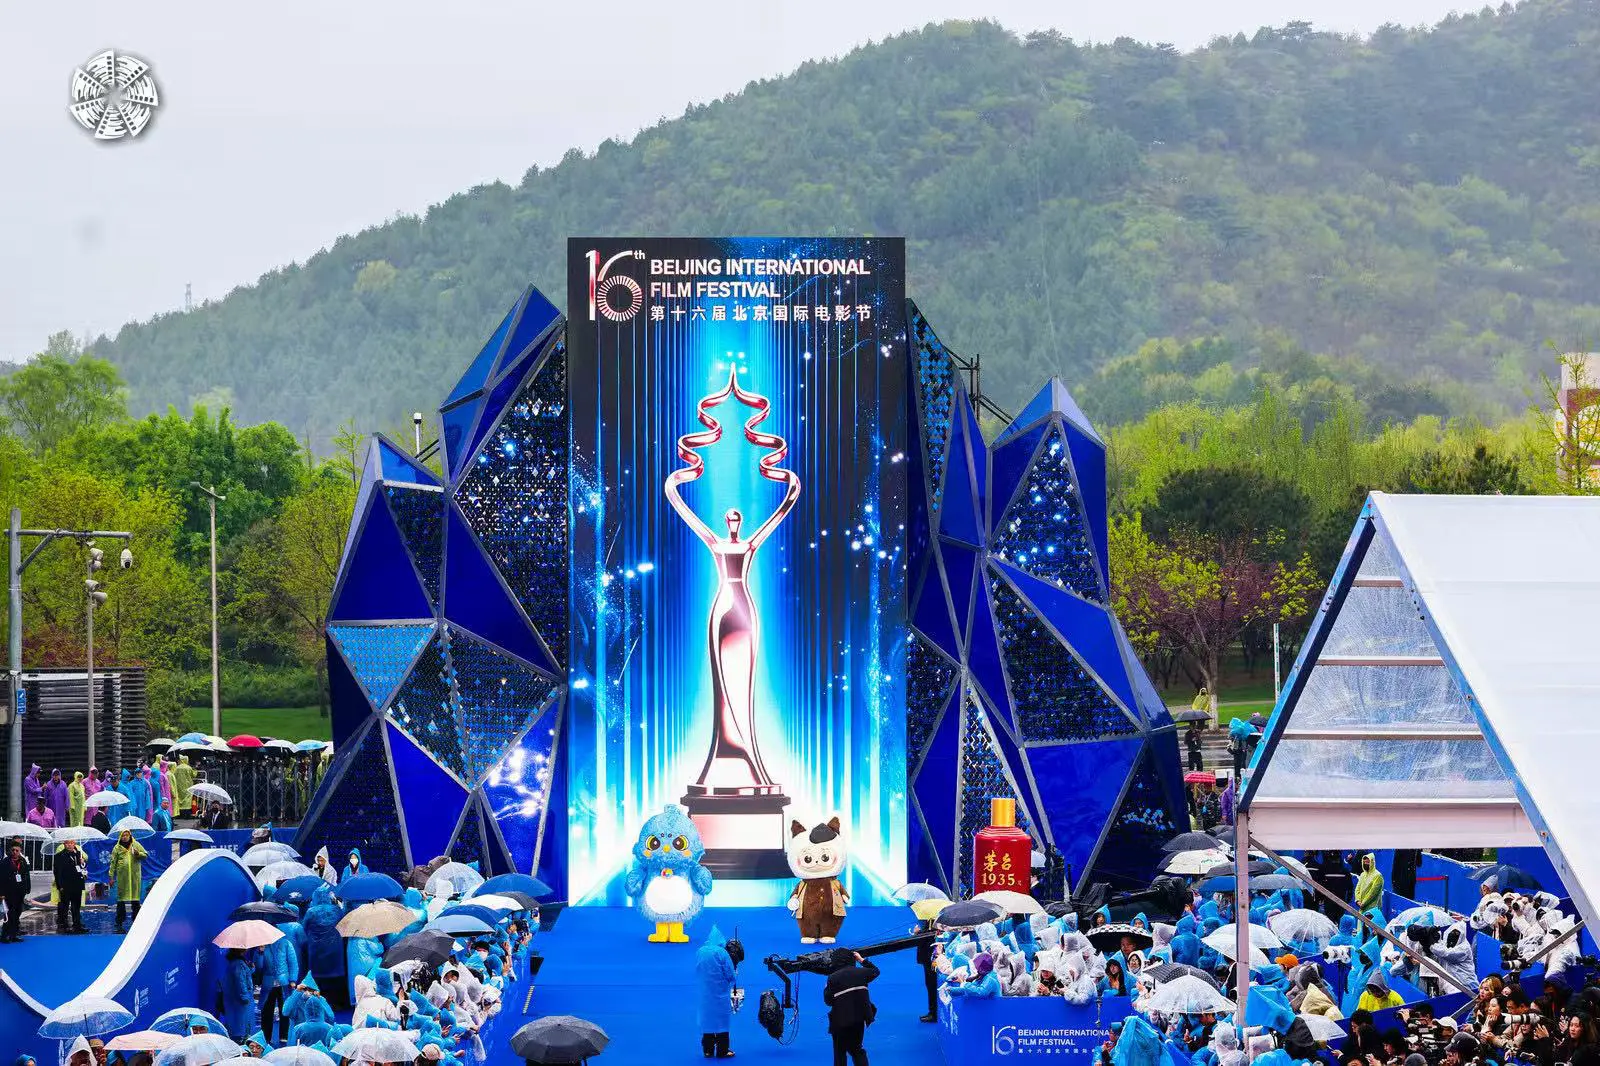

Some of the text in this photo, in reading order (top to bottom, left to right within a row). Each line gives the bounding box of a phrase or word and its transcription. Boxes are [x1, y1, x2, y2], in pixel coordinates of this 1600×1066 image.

[650, 259, 871, 275] BEIJING INTERNATIONAL
[650, 281, 781, 298] FILM FESTIVAL
[650, 304, 872, 322] 第十六届北京国际电影节
[983, 850, 1012, 872] 茅台
[981, 872, 1016, 886] 1935
